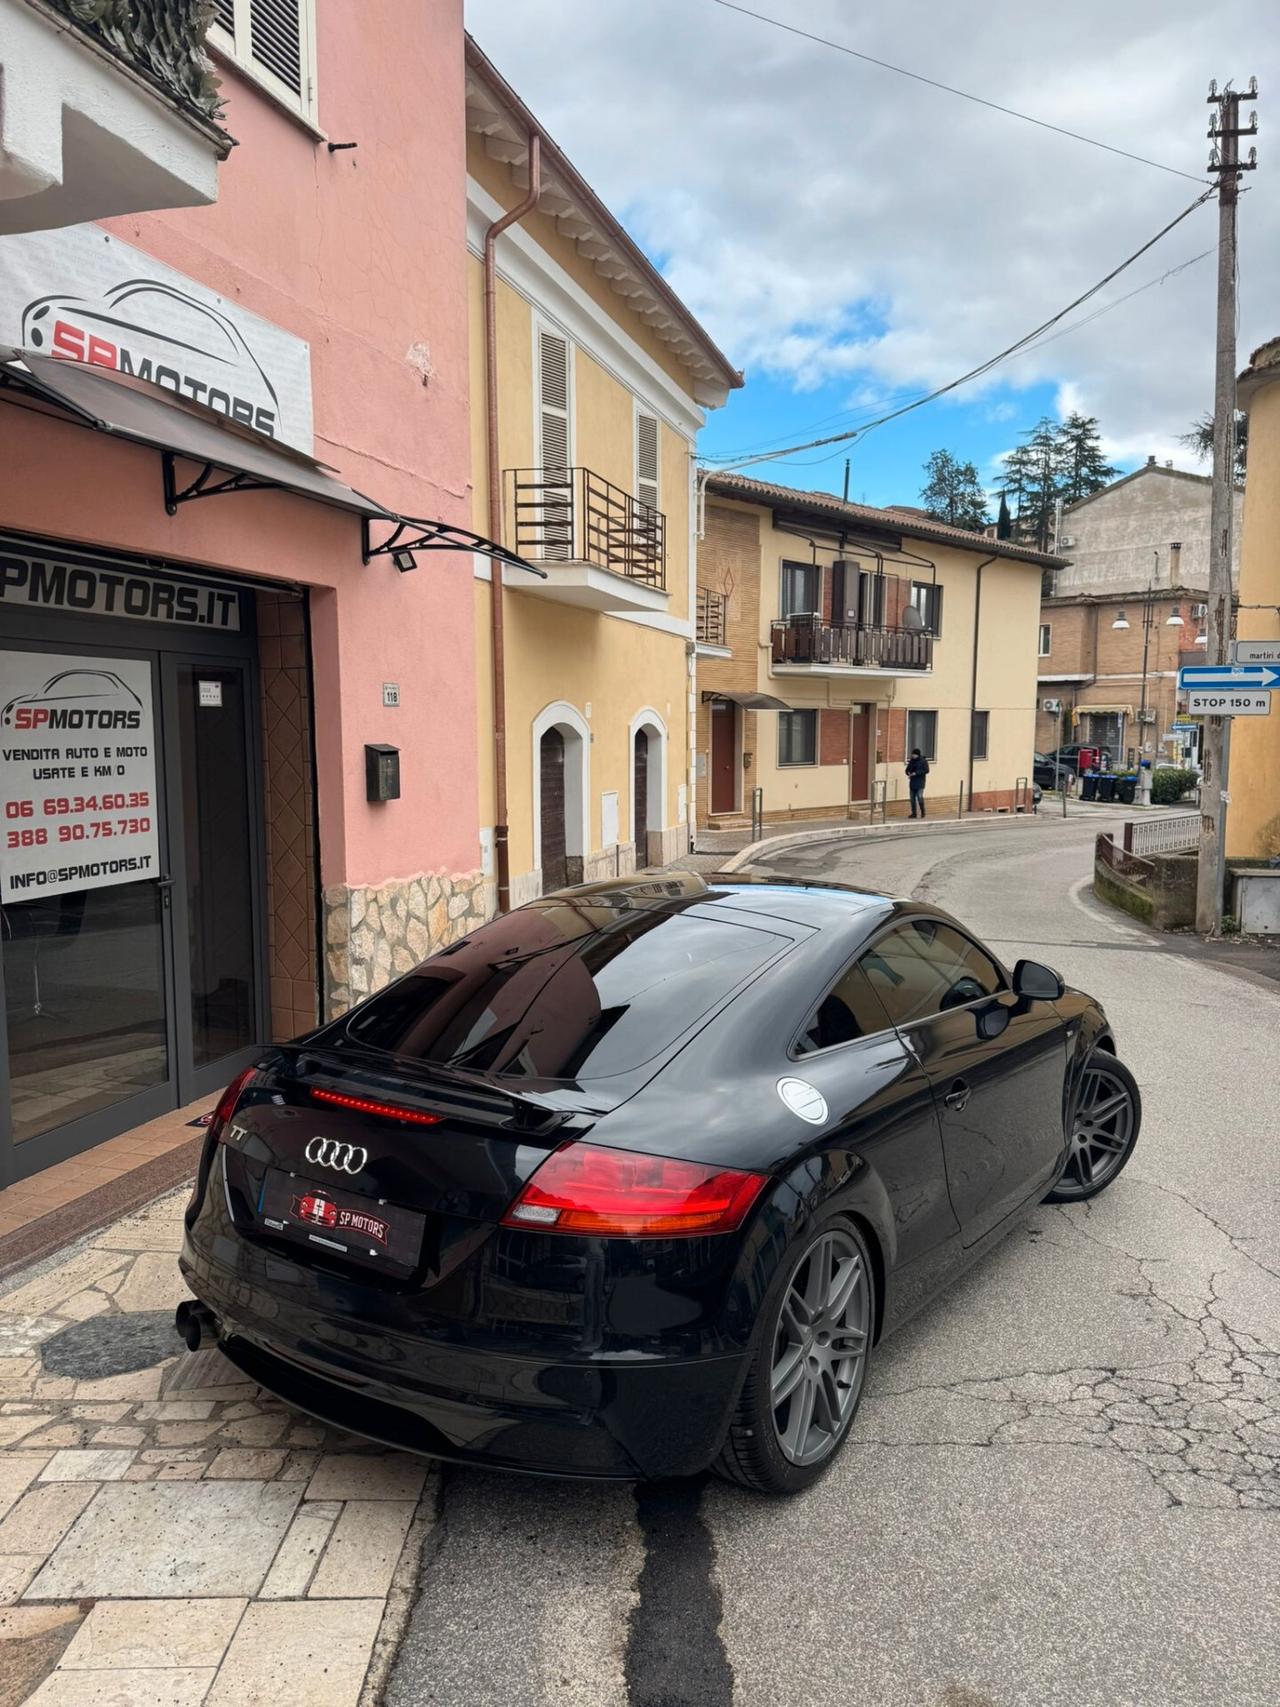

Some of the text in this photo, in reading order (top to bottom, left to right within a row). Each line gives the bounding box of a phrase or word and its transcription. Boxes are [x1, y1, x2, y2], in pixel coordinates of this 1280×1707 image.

[1249, 651, 1274, 660] martiri
[1193, 698, 1226, 707] STOP
[1230, 698, 1251, 707] 150
[15, 708, 141, 729] SPMOTORS
[3, 746, 148, 761] VENDITA AUTO E MOTO
[33, 767, 75, 780] USATE
[81, 766, 89, 777] E
[94, 765, 112, 777] KM
[5, 792, 150, 819] 06 69.34.60.35
[7, 817, 151, 848] 388 90.75.730
[10, 855, 152, 890] INFO@SPMOTORS.IT
[230, 1124, 248, 1141] TT
[339, 1211, 385, 1239] SP MOTORS
